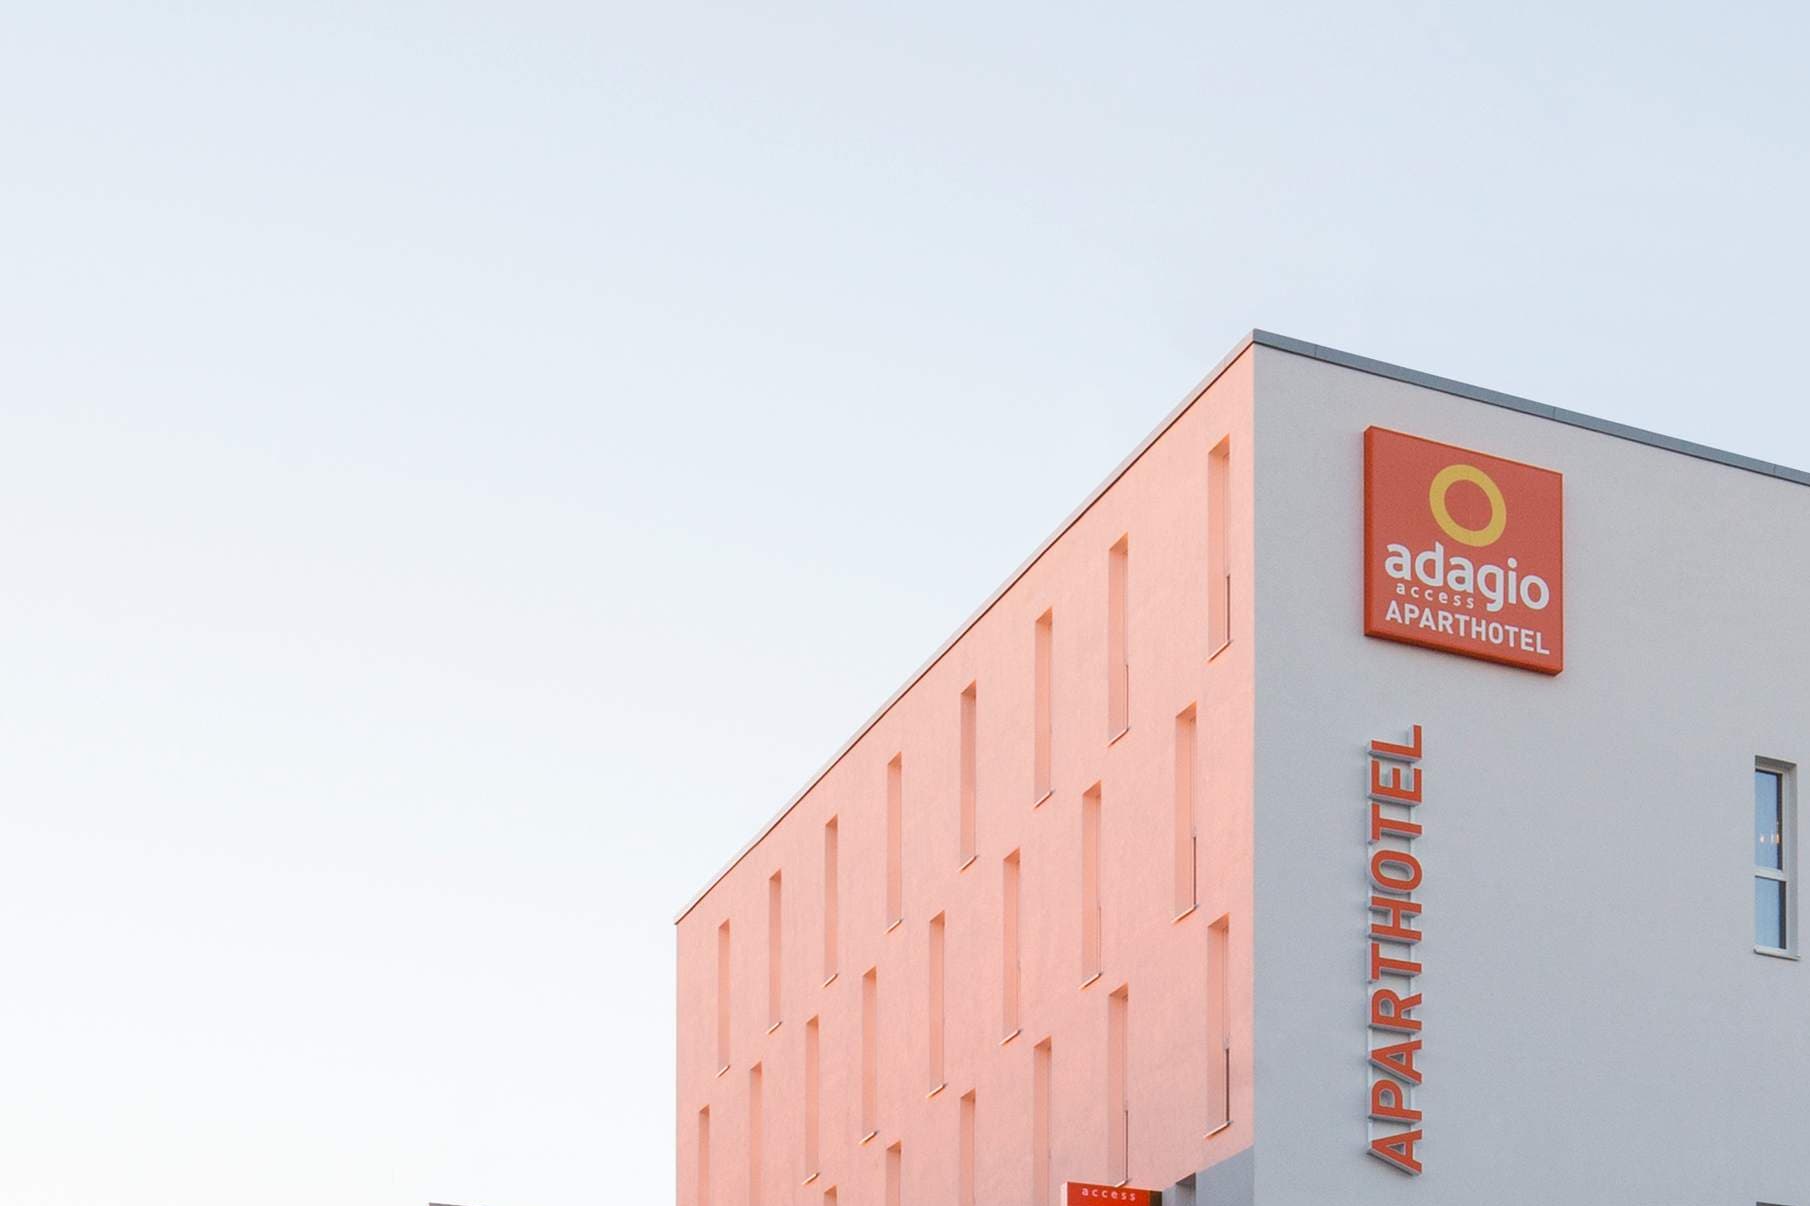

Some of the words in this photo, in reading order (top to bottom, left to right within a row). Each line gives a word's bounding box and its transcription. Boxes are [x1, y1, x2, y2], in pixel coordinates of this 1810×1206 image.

[1385, 541, 1549, 612] adagio
[1396, 583, 1474, 609] access
[1385, 600, 1549, 654] APARTHOTEL
[1367, 724, 1423, 1176] APARTHOTEL
[1081, 1187, 1136, 1201] access
